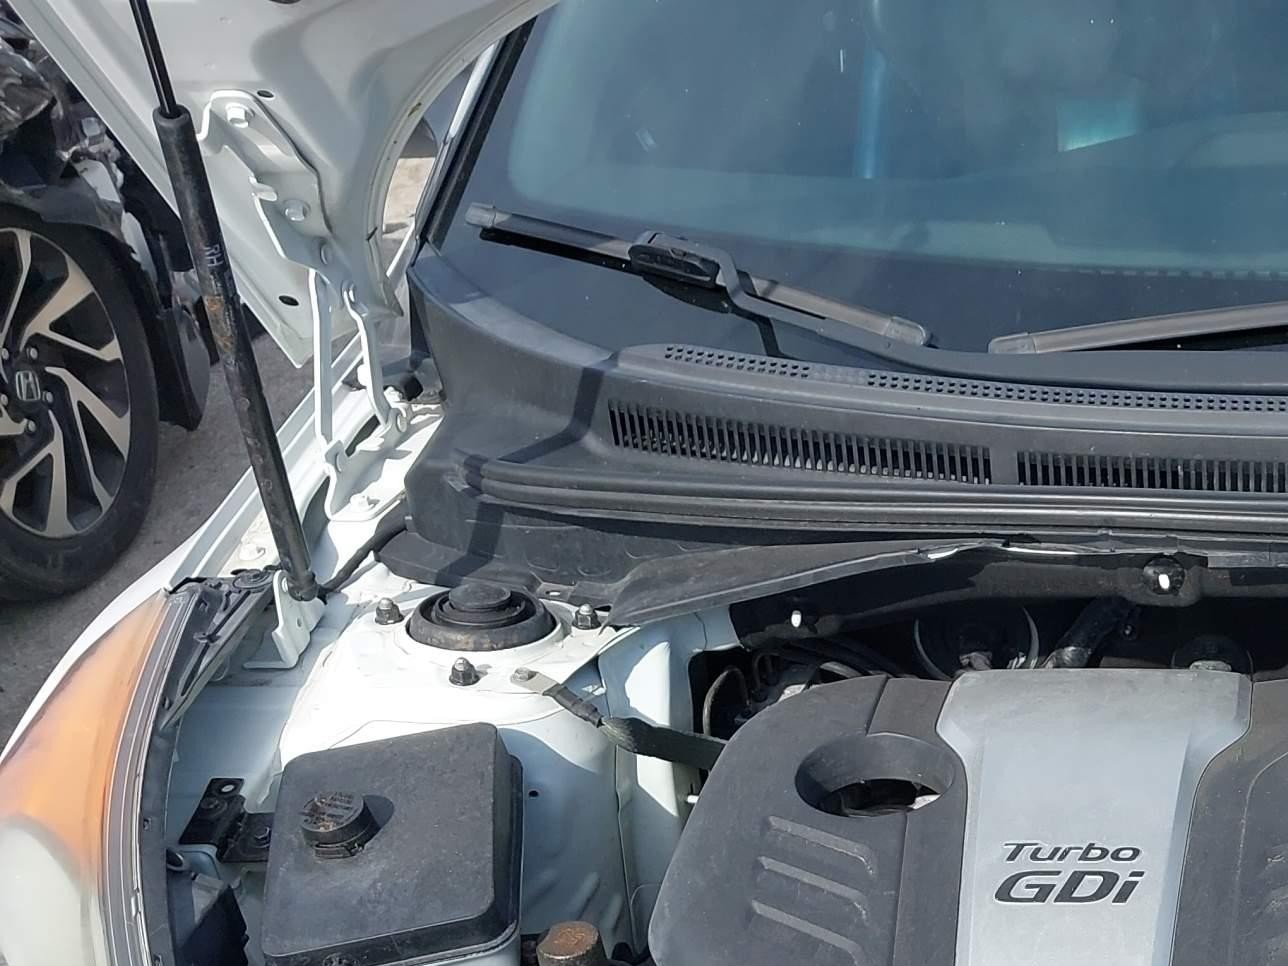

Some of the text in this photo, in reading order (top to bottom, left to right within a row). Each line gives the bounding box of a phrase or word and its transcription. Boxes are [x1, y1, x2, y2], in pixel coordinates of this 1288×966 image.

[203, 244, 224, 267] RH
[1004, 842, 1141, 862] Turbo
[994, 870, 1145, 904] GDi
